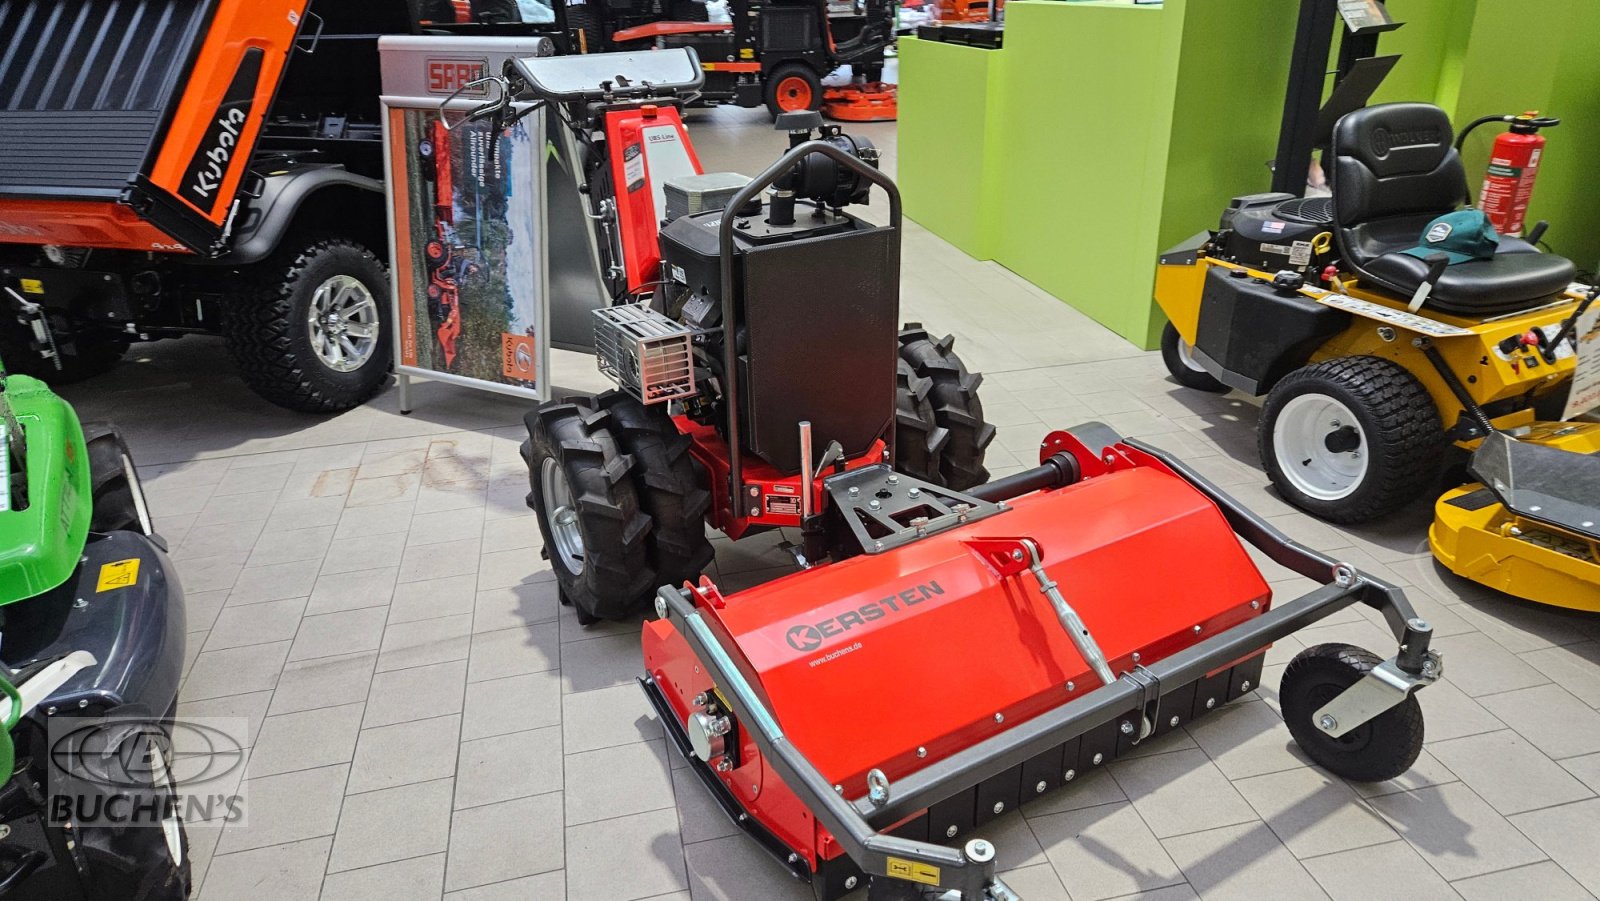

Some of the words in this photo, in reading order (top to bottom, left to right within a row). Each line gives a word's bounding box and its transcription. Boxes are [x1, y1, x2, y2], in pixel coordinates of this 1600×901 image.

[192, 108, 246, 197] Kubota
[469, 130, 478, 178] Allrounder
[786, 580, 945, 652] KERSTEN
[808, 641, 863, 669] www.buchens.de
